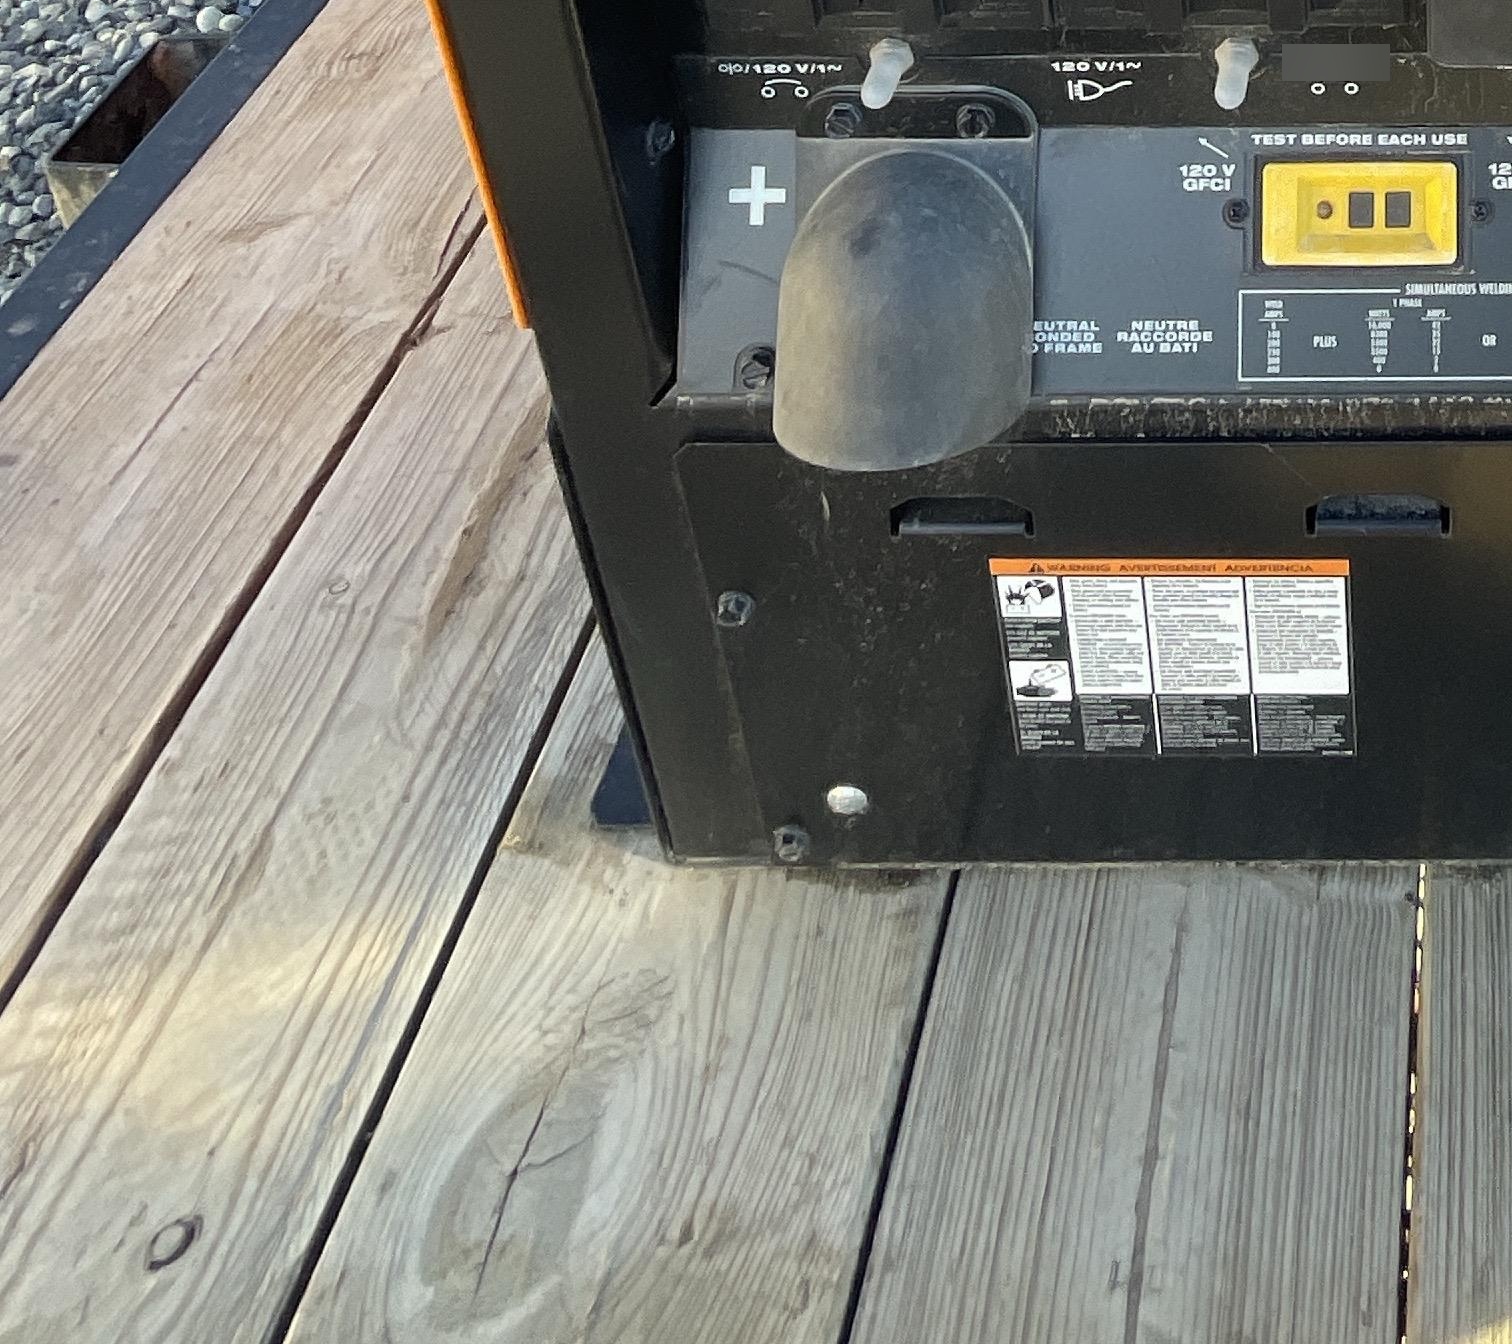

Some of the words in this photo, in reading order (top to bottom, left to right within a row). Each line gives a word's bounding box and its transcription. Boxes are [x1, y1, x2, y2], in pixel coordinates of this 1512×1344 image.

[1050, 61, 1091, 73] 120
[1250, 134, 1298, 146] TEST
[1300, 134, 1372, 146] BEFORE
[1378, 134, 1426, 146] EACH
[1430, 133, 1468, 145] USE
[1179, 164, 1217, 177] 120
[1221, 164, 1236, 177] V
[1182, 178, 1231, 191] GFCI
[1405, 283, 1477, 295] SIMULTANEOUS
[1032, 320, 1100, 331] EUTRAL
[1131, 320, 1199, 331] NEUTRE
[1033, 331, 1095, 342] ONDED
[1313, 335, 1338, 348] PLUS
[1482, 334, 1497, 347] OR
[1044, 342, 1103, 354] FRAME
[1131, 342, 1155, 353] AU
[1159, 342, 1198, 353] BATI
